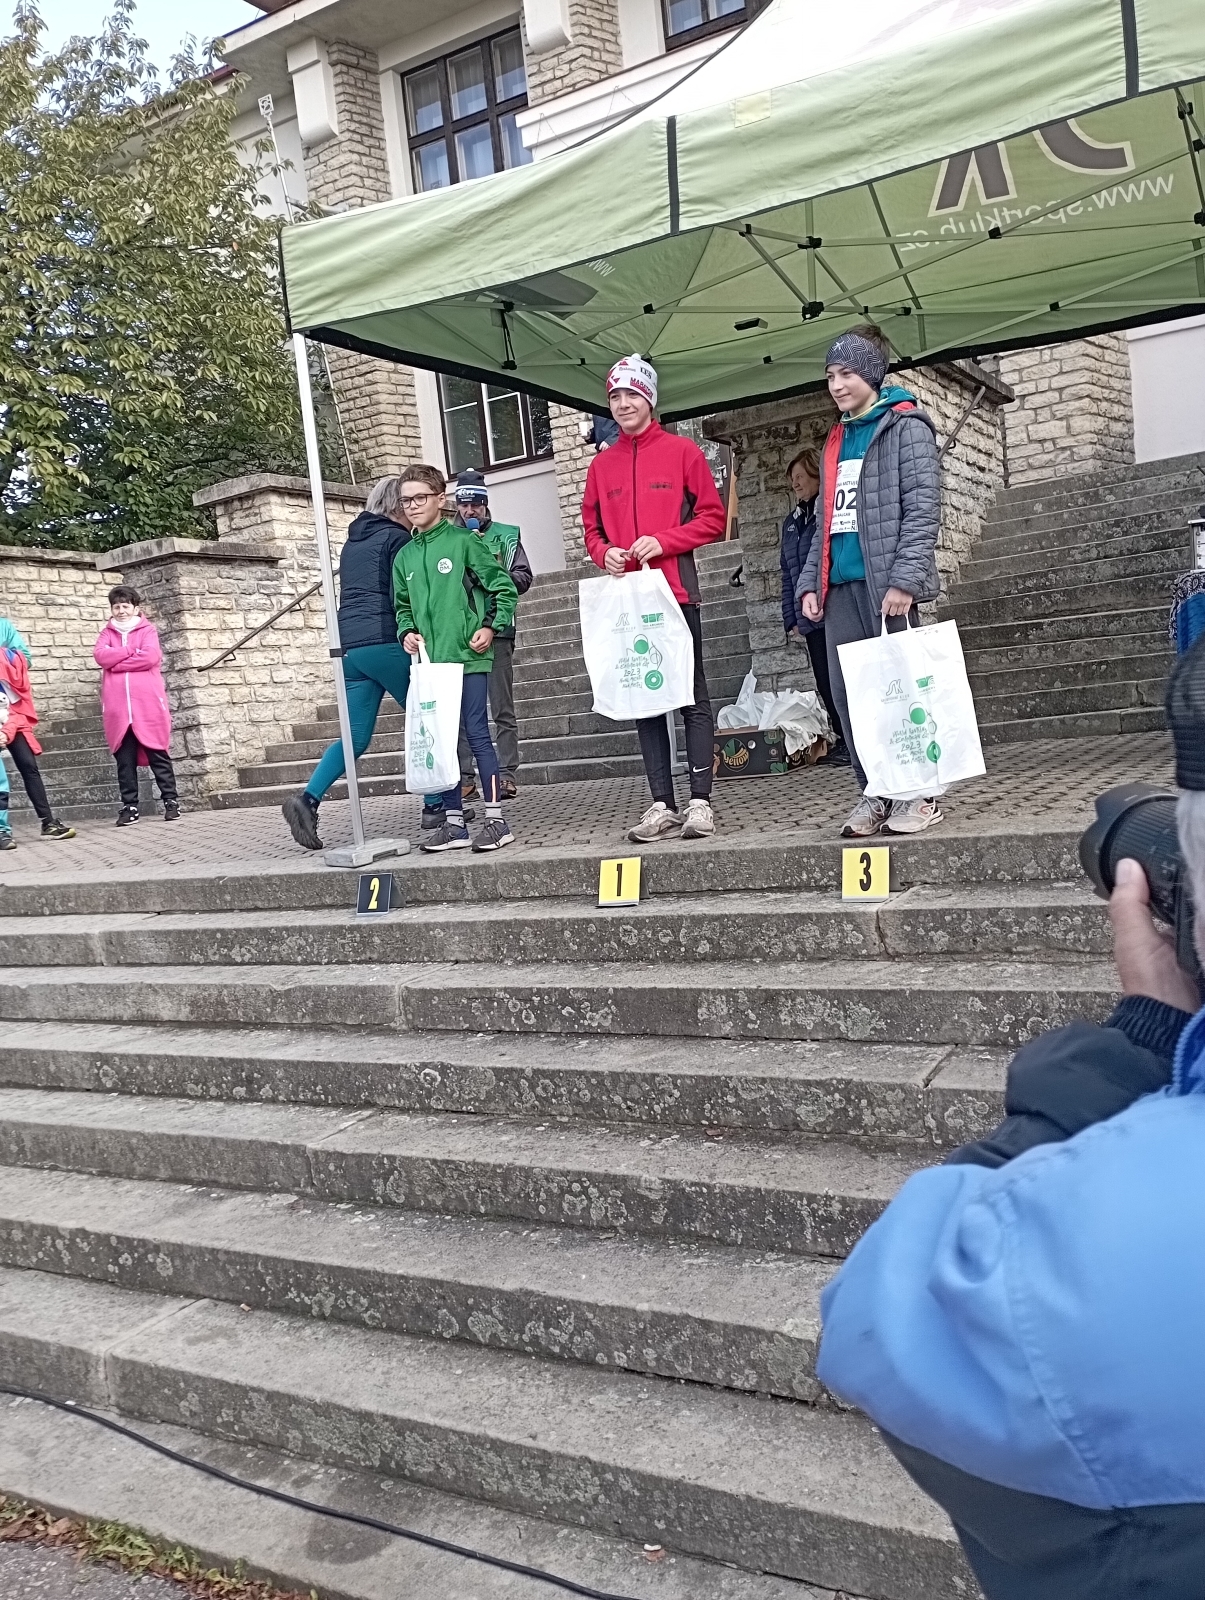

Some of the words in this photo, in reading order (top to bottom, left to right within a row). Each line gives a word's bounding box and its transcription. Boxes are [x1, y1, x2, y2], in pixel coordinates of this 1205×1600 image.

[623, 667, 641, 678] 2023
[900, 740, 922, 753] 2023
[616, 863, 623, 897] 1
[859, 851, 872, 892] 3
[367, 877, 380, 910] 2
